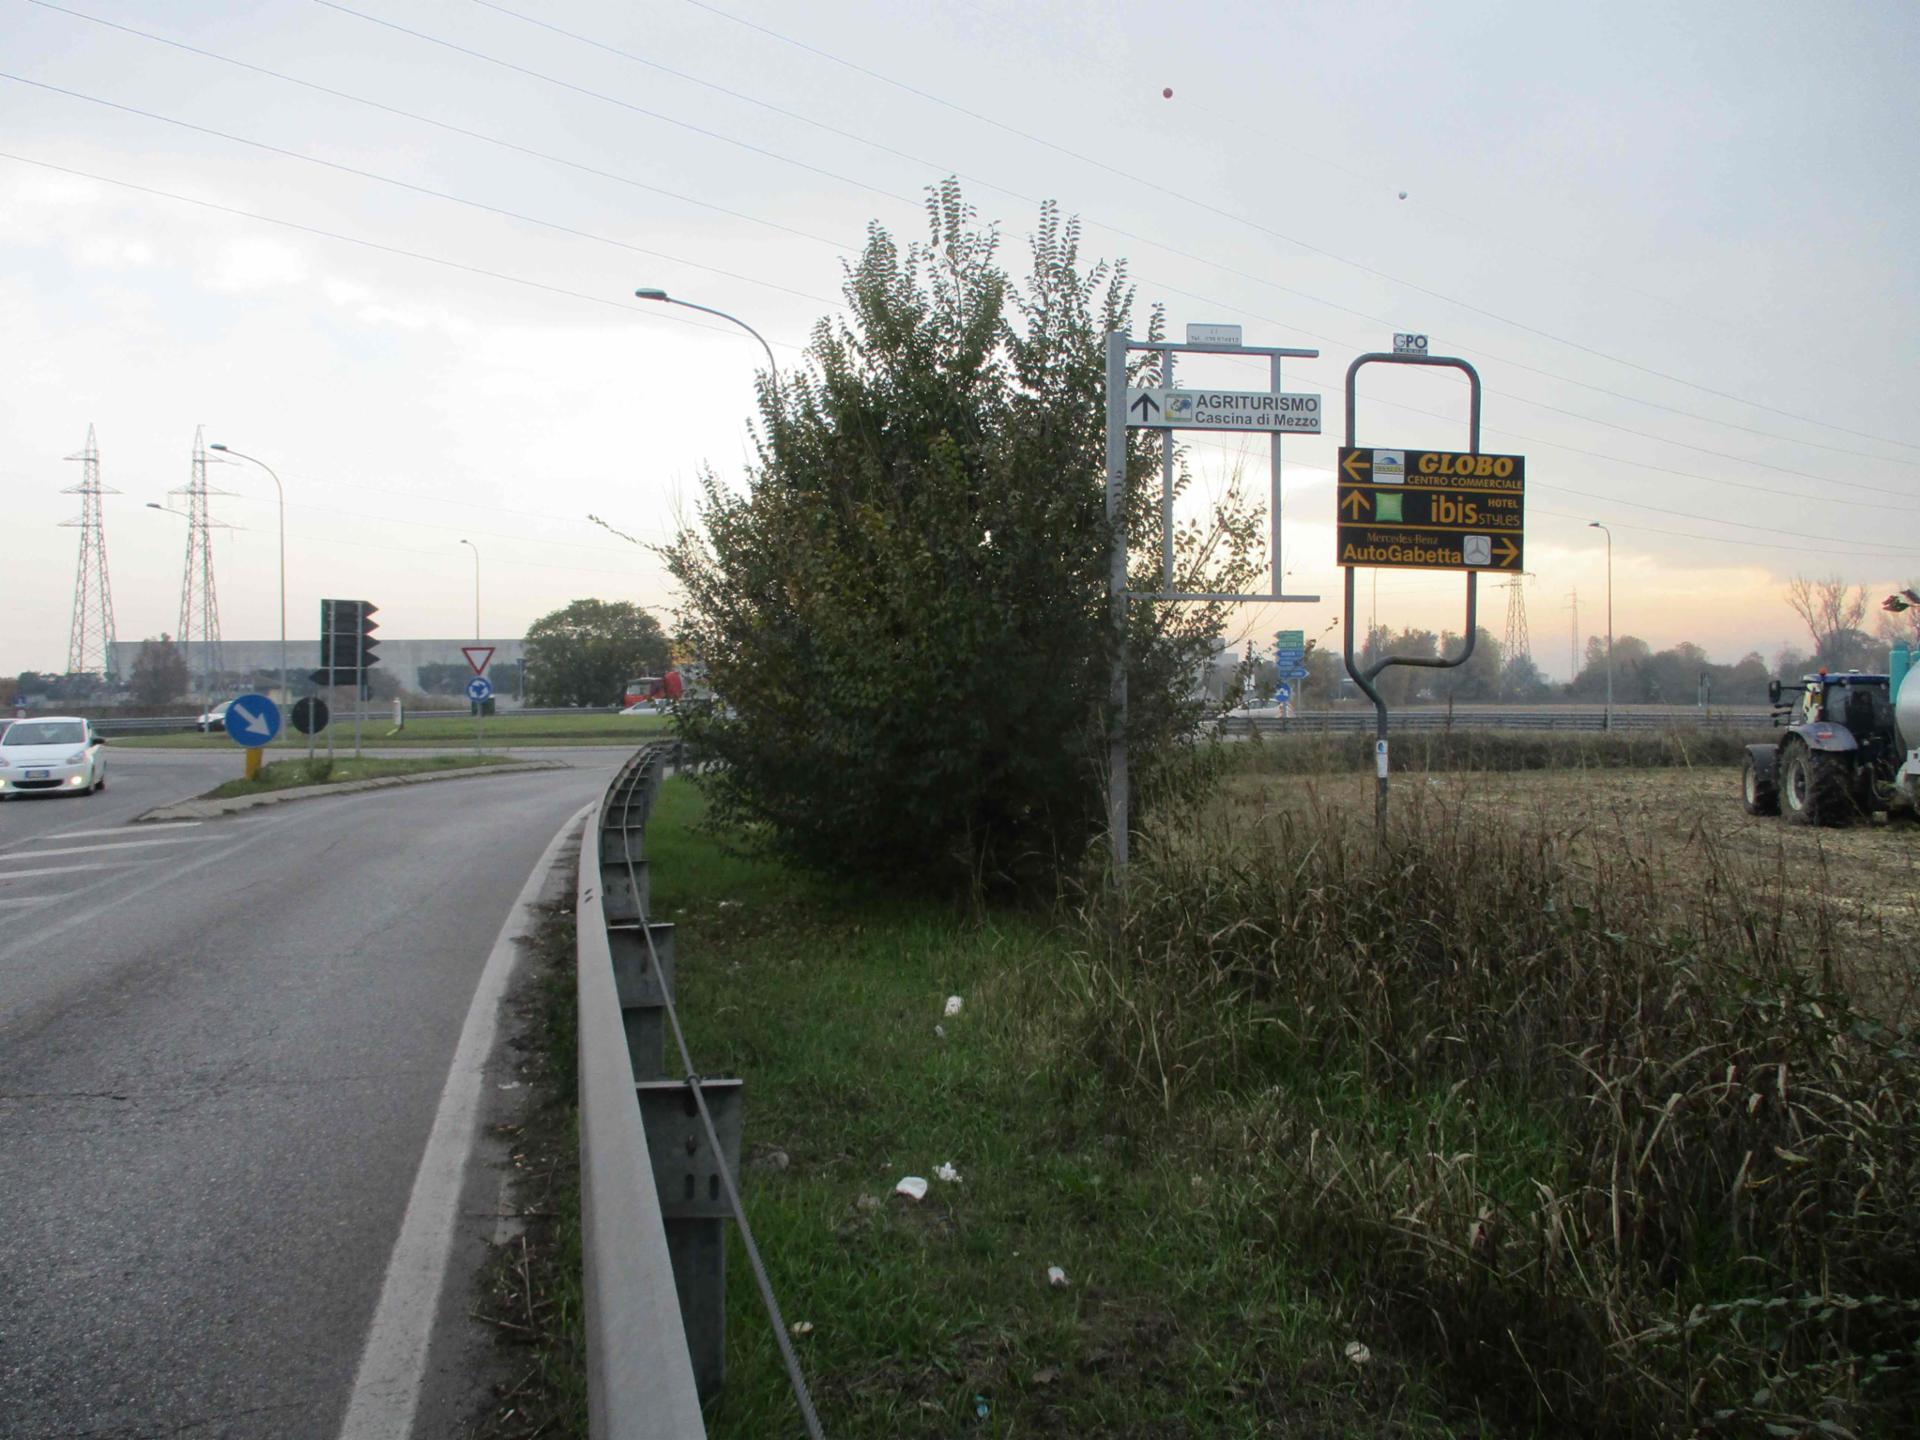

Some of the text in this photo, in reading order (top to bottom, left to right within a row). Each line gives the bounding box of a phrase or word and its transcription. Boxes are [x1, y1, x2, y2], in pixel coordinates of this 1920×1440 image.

[1393, 334, 1428, 349] GPO
[1195, 394, 1318, 412] AGRITURISMO
[1195, 411, 1319, 427] Cascina di Mezzo
[1418, 453, 1514, 478] GLOBO
[1407, 475, 1523, 489] CENTRO COMMERCIALE
[1431, 494, 1478, 524] ibis
[1487, 498, 1519, 509] HOTEL
[1367, 532, 1439, 546] Mercedes-Benz
[1343, 543, 1463, 564] AutoGabetta
